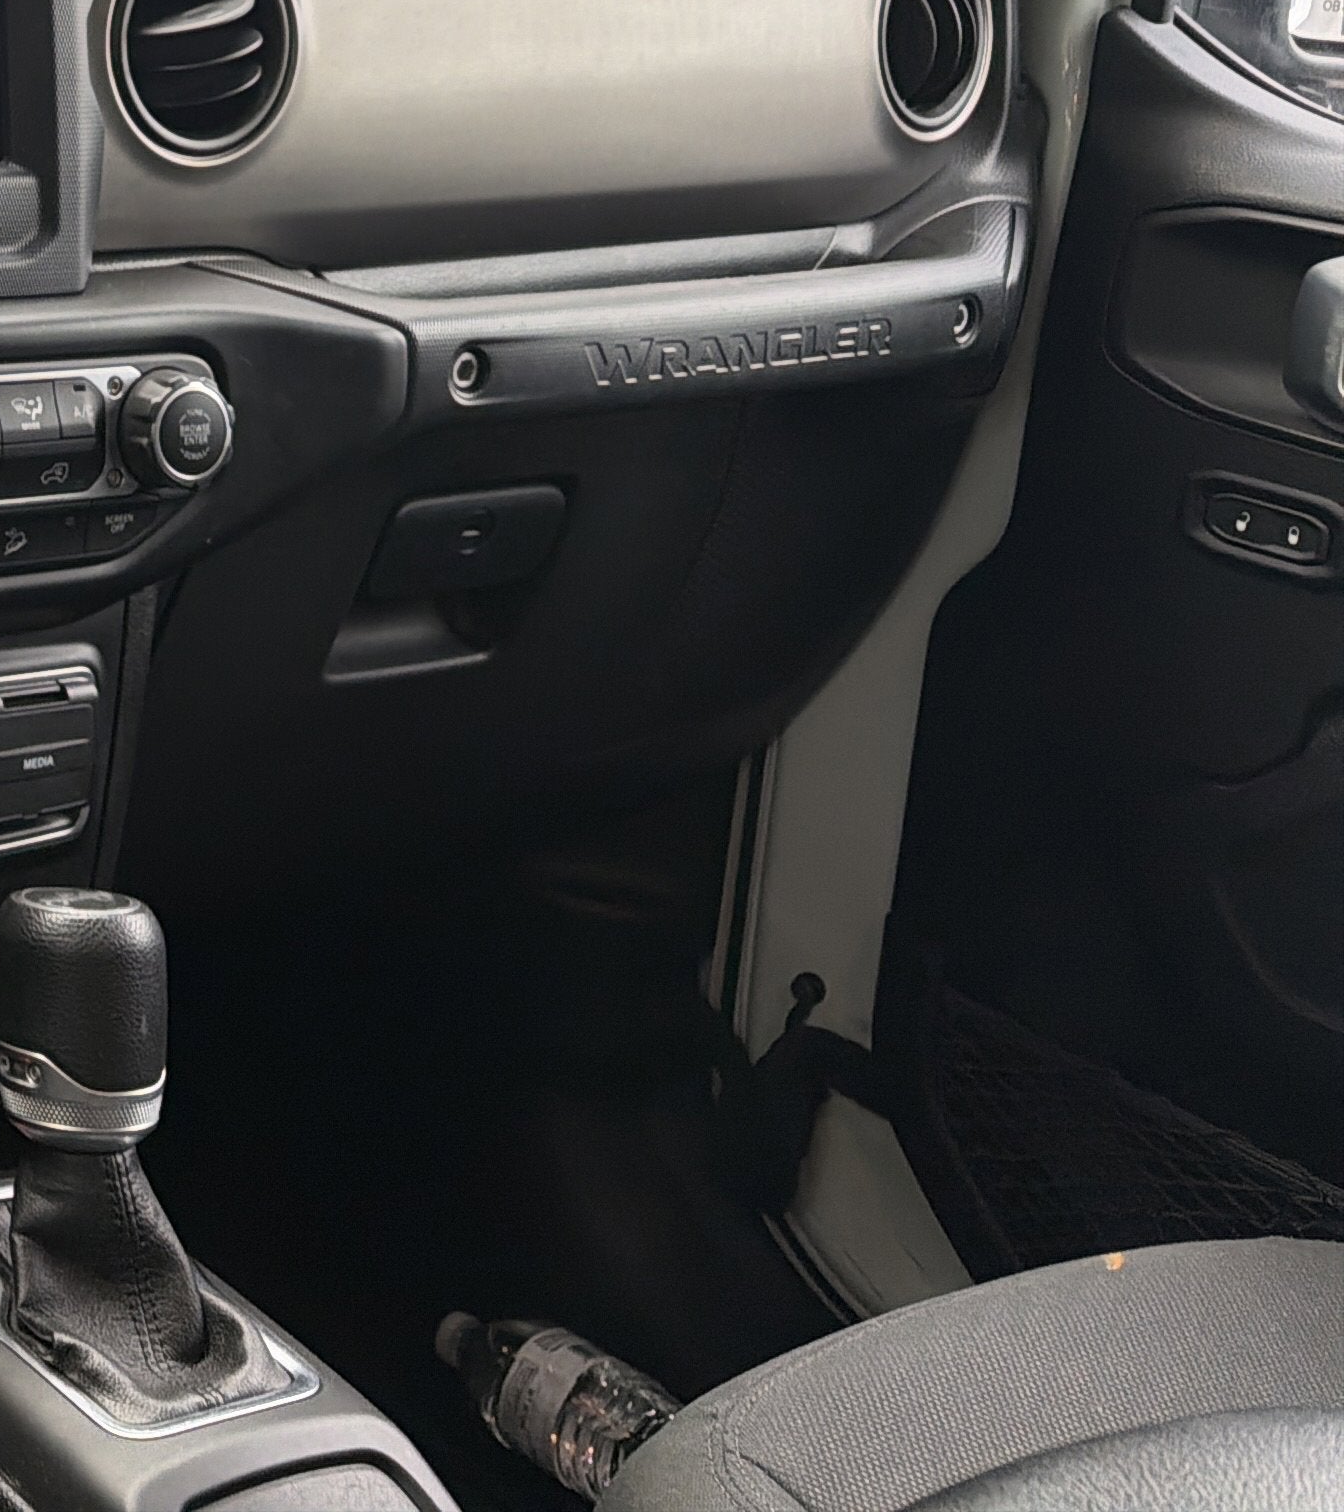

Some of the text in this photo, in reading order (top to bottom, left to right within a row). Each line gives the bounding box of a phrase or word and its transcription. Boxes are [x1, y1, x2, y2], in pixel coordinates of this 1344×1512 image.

[583, 317, 892, 387] WRANGLER
[184, 434, 208, 446] ENTER
[22, 755, 54, 769] MEDIA
